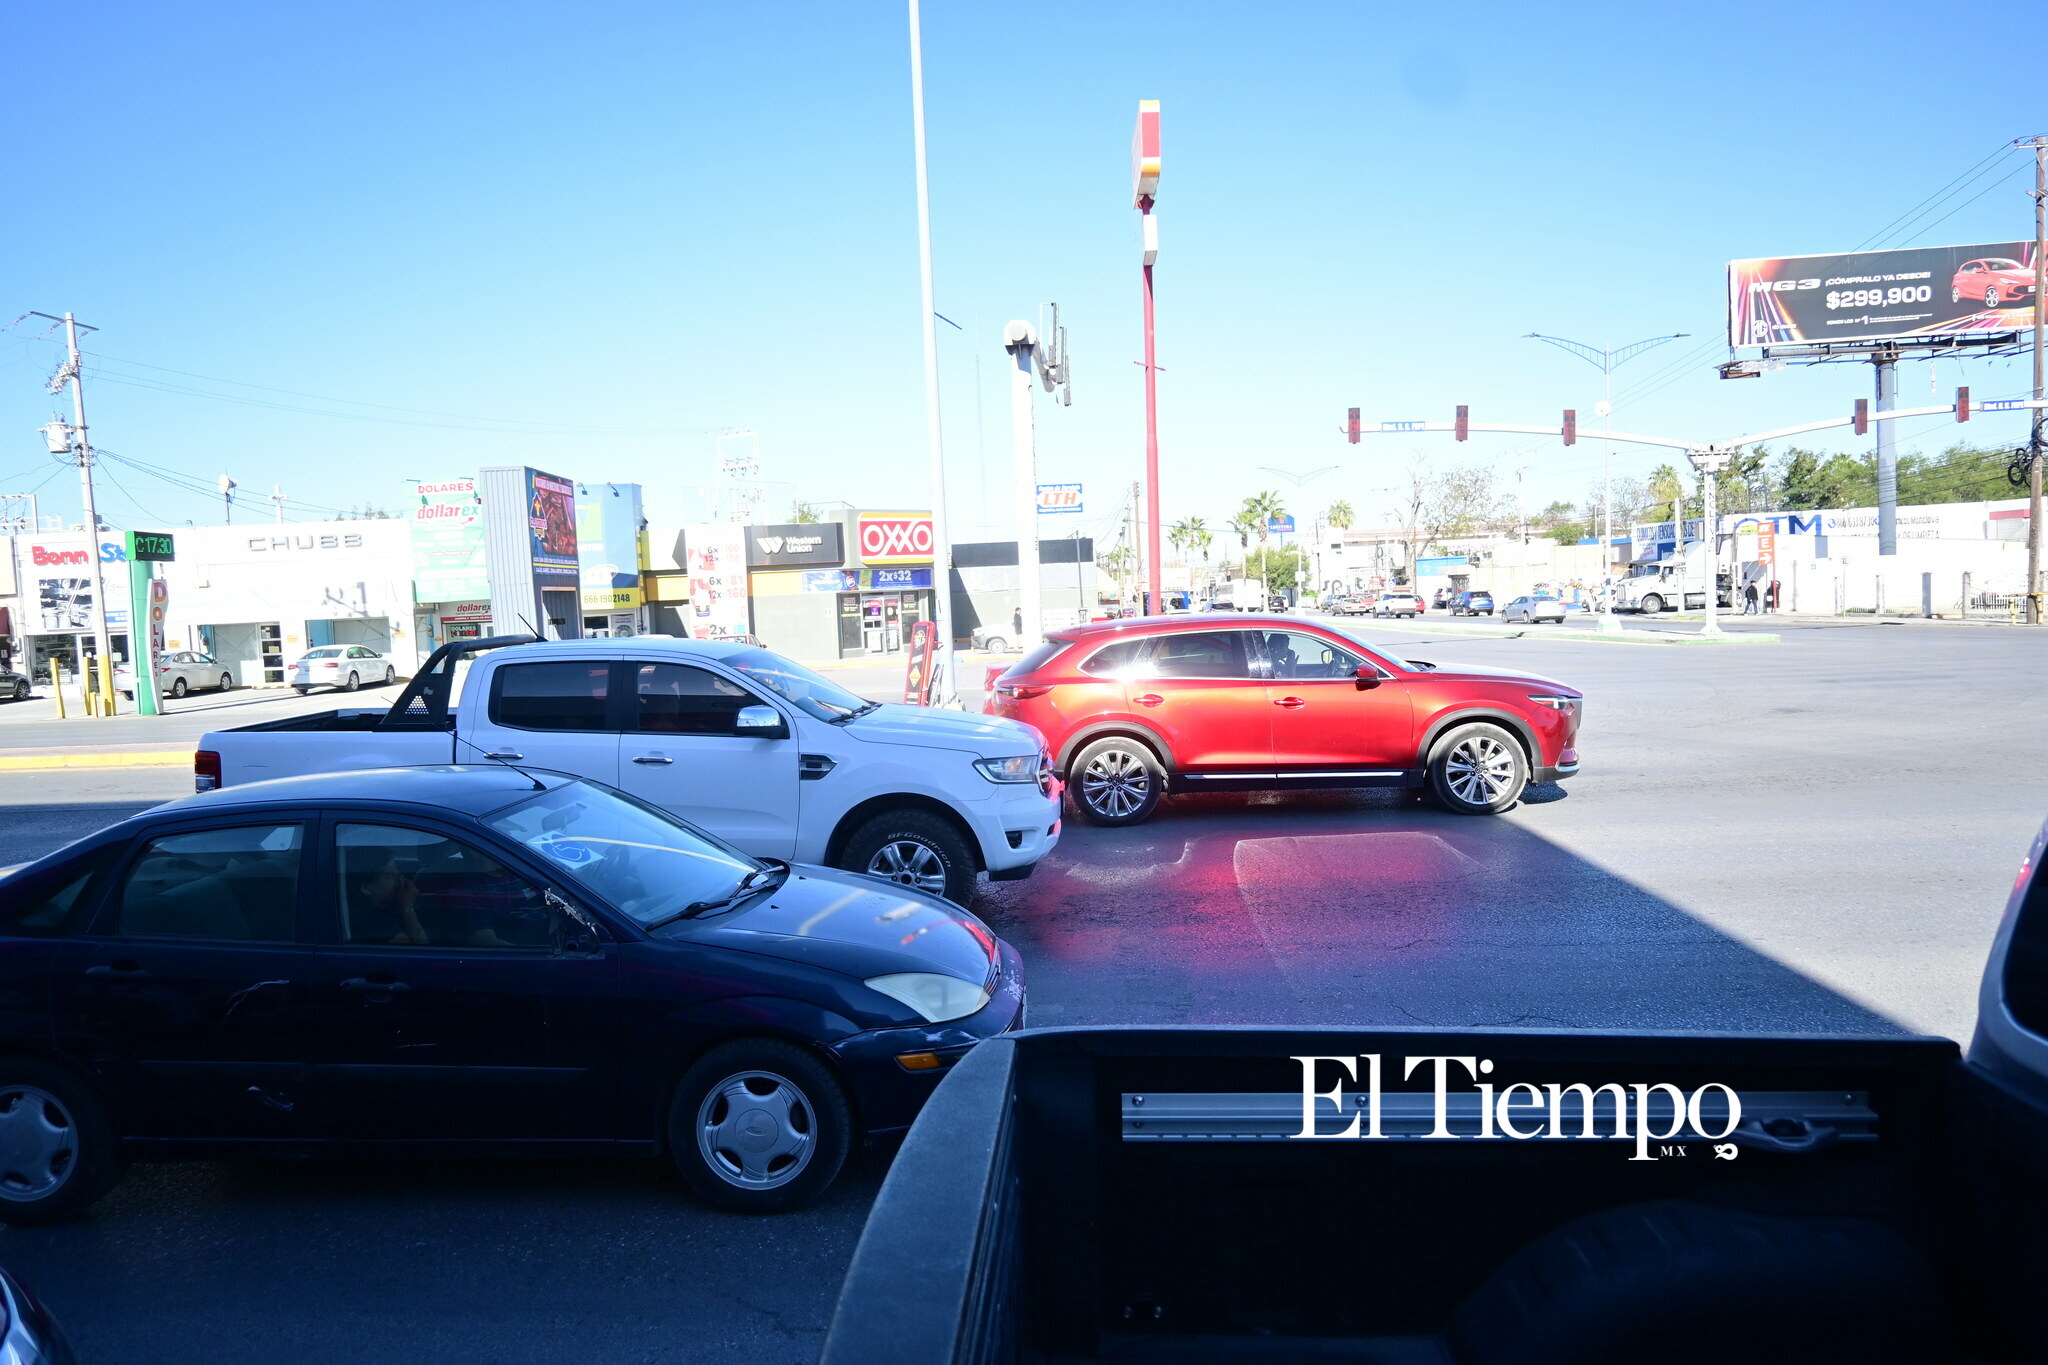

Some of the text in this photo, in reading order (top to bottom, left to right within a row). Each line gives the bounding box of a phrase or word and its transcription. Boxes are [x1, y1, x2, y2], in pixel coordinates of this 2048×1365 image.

[1882, 274, 1894, 282] YA
[1748, 278, 1822, 294] MG3
[1826, 285, 1932, 310] $299,900
[1861, 315, 1869, 325] 1
[417, 482, 475, 494] DOLARES
[1043, 492, 1077, 505] LTH
[417, 504, 480, 520] dollarex
[248, 534, 363, 552] CHUBB
[785, 536, 823, 546] Western
[862, 520, 933, 556] OXXO
[786, 544, 814, 554] Union
[31, 546, 89, 566] Bonn
[709, 576, 723, 586] 6x
[584, 595, 599, 604] 866
[457, 603, 492, 613] dollarex
[152, 581, 167, 678] DOLARES
[708, 623, 728, 636] 2x
